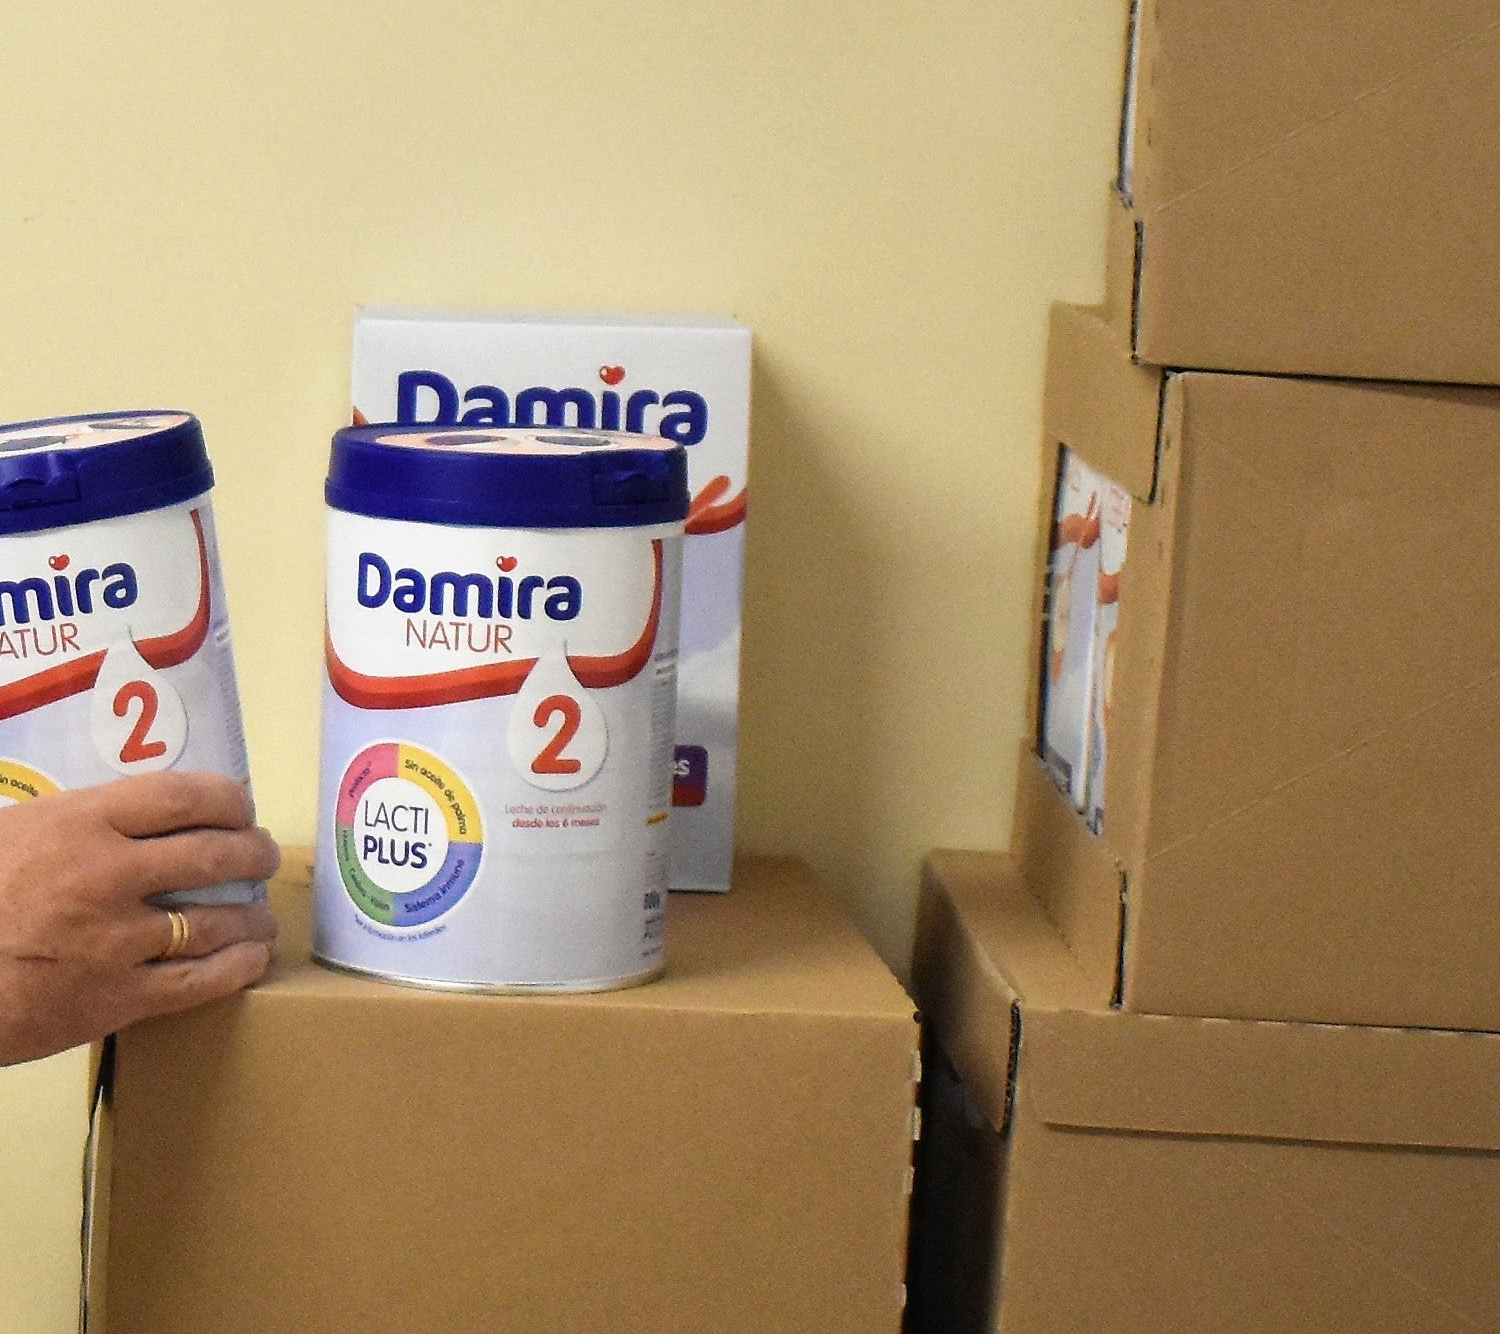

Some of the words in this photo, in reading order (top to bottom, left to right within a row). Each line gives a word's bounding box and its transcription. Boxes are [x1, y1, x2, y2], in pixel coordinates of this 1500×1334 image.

[397, 365, 709, 447] Damira
[357, 552, 583, 621] Damira
[405, 618, 514, 654] NATUR
[112, 680, 167, 764] 2
[531, 693, 582, 775] 2
[364, 800, 429, 835] LACTI
